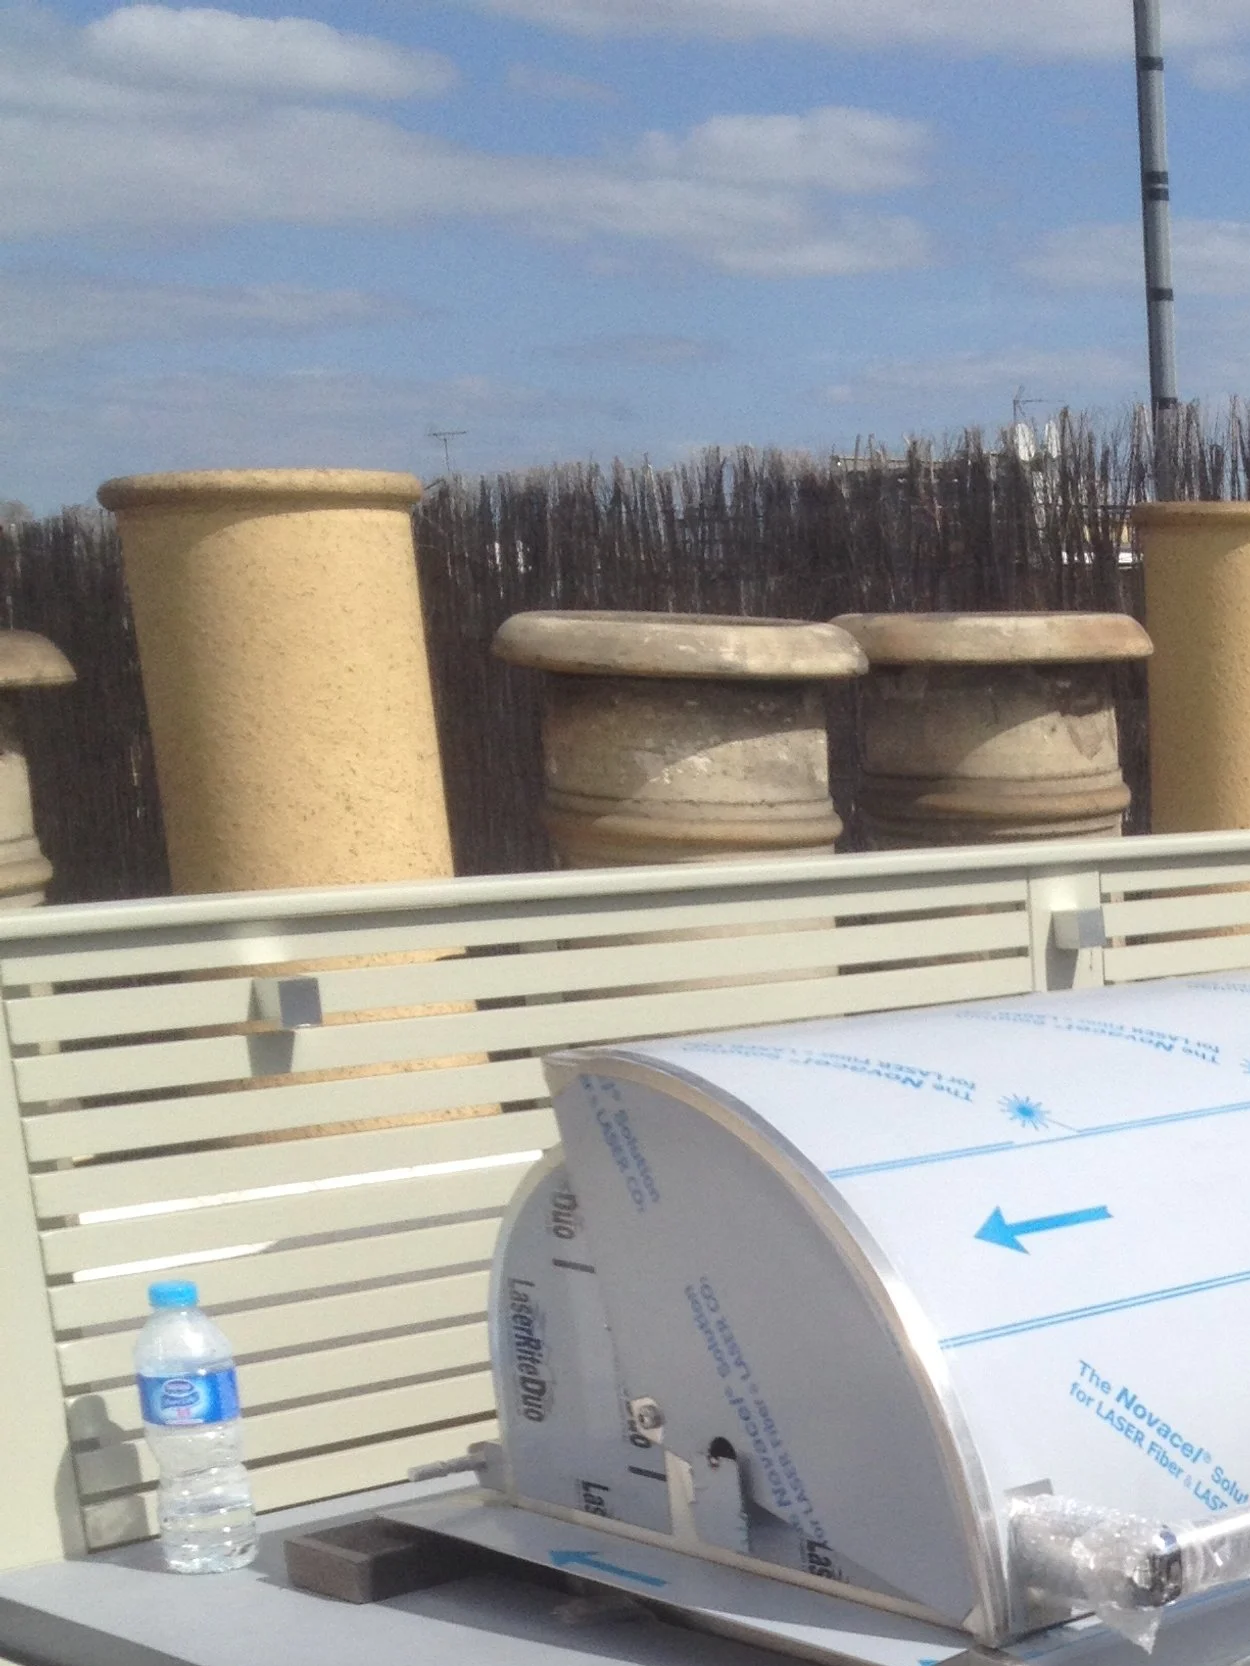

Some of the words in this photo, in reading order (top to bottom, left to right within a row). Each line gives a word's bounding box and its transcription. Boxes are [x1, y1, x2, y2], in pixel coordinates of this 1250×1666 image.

[1079, 1360, 1112, 1394] The
[1069, 1381, 1095, 1406] for
[1096, 1401, 1145, 1448] LASER
[1147, 1440, 1184, 1478] Fiber
